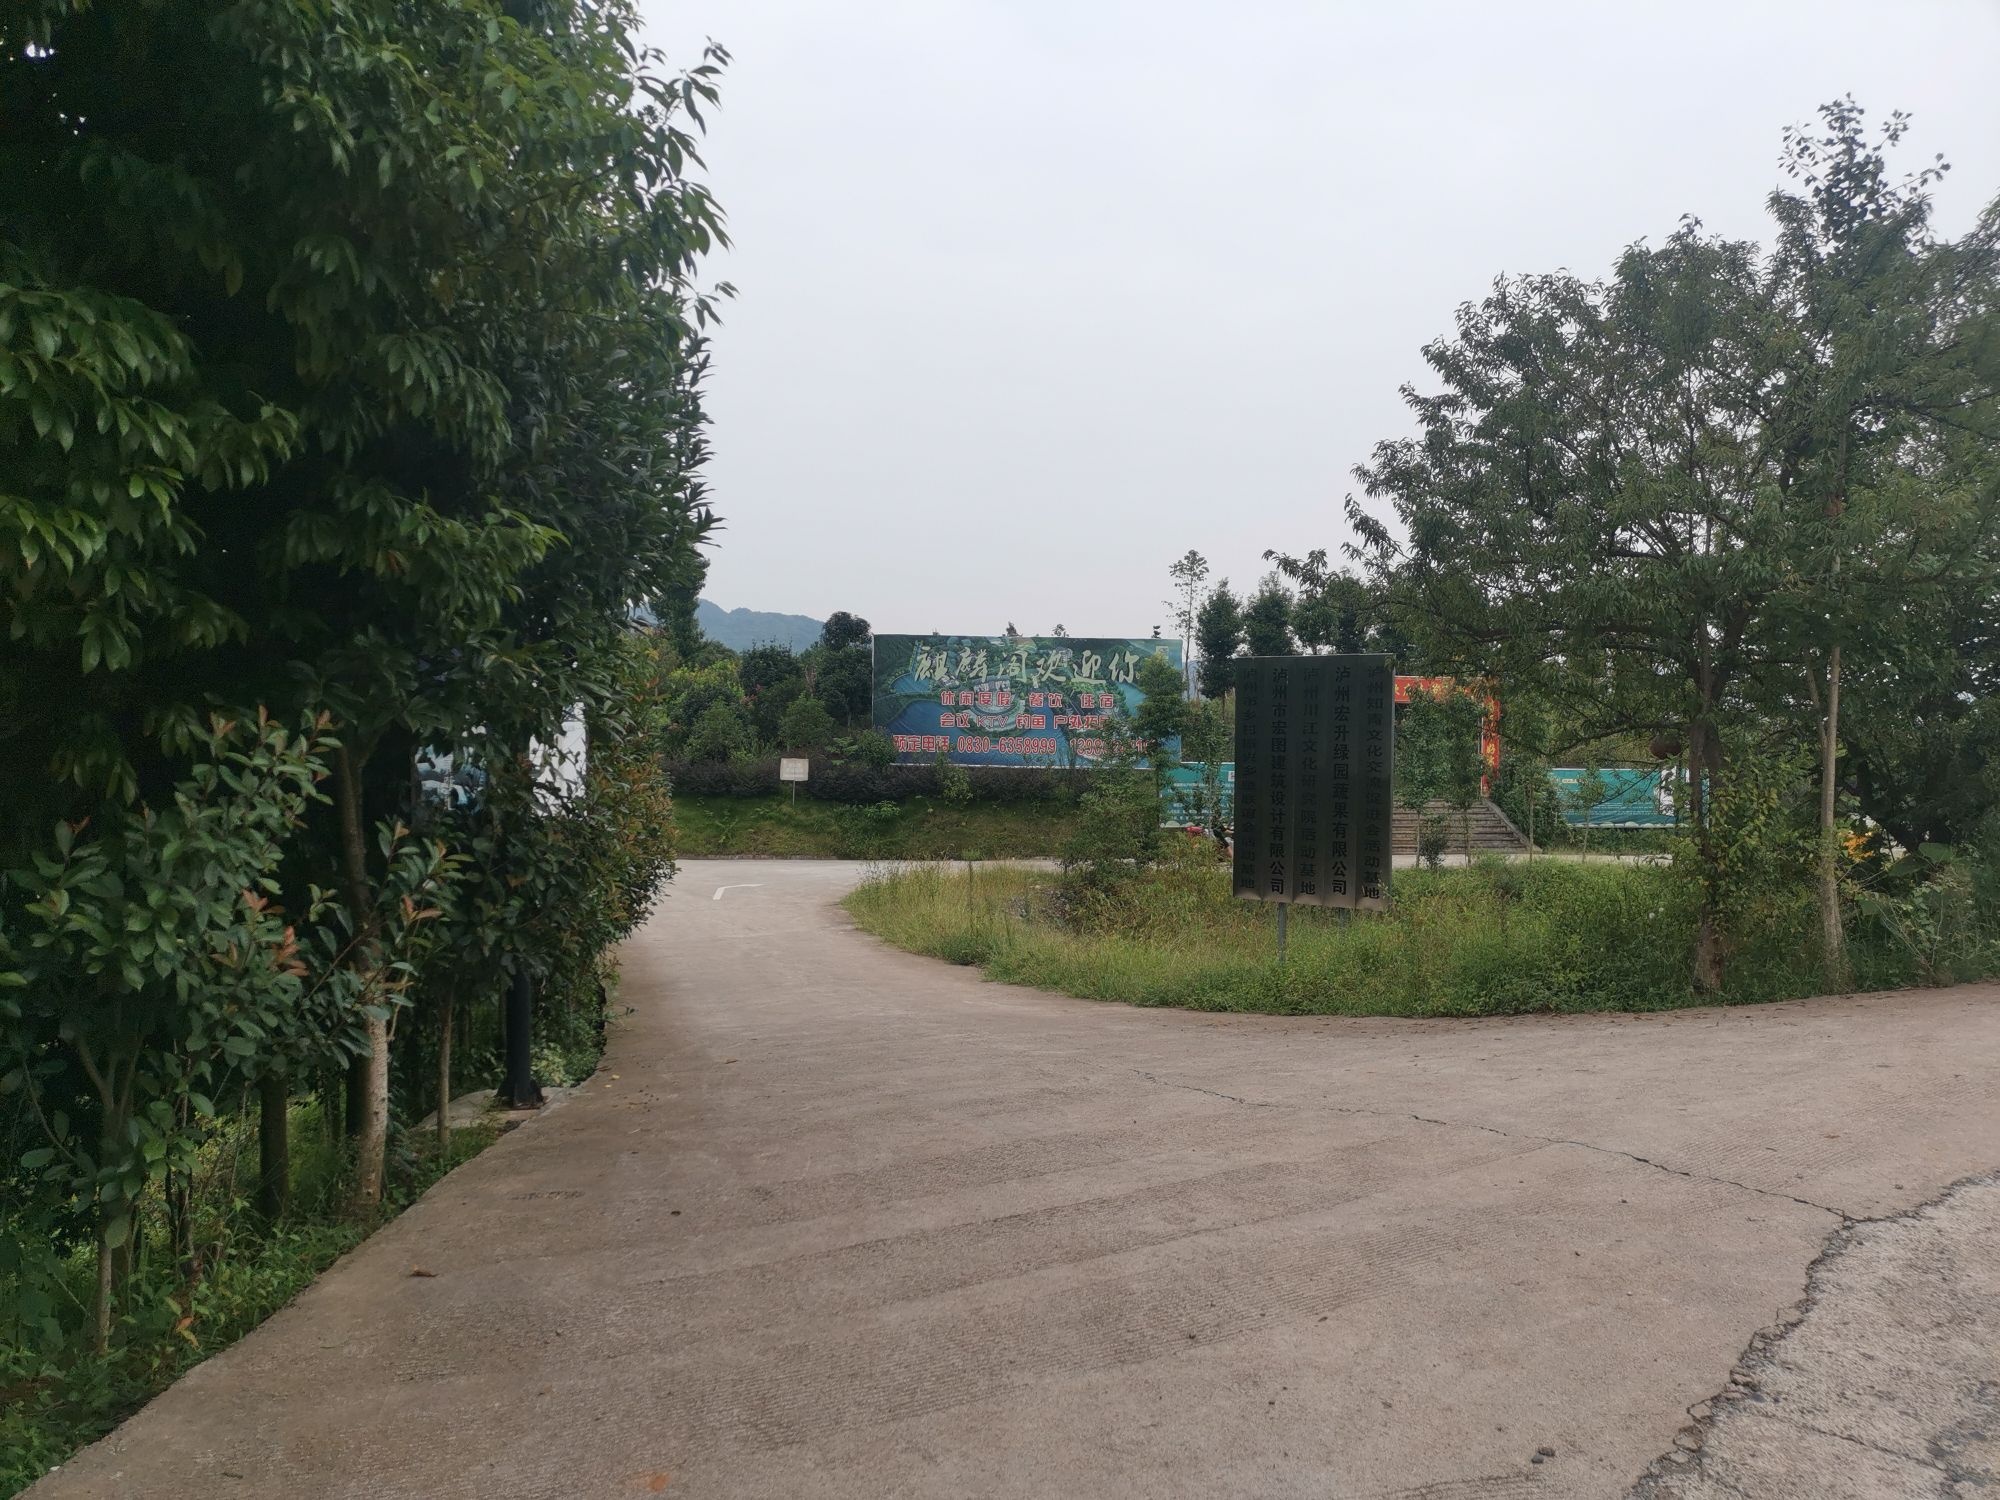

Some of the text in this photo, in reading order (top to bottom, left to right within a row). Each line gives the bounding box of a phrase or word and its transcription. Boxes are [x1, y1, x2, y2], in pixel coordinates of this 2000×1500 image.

[940, 690, 1115, 709] 休闲度假 餐饮 住宿
[940, 714, 971, 729] 会议
[977, 716, 1008, 728] KTV
[1015, 714, 1046, 730] 钓鱼
[1269, 668, 1289, 895] 泸州市宏图建筑设计有限公司
[1299, 668, 1319, 894] 泸州川江文化研究院活动基地
[1331, 667, 1352, 895] 泸州宏升绿园蔬果有限公司
